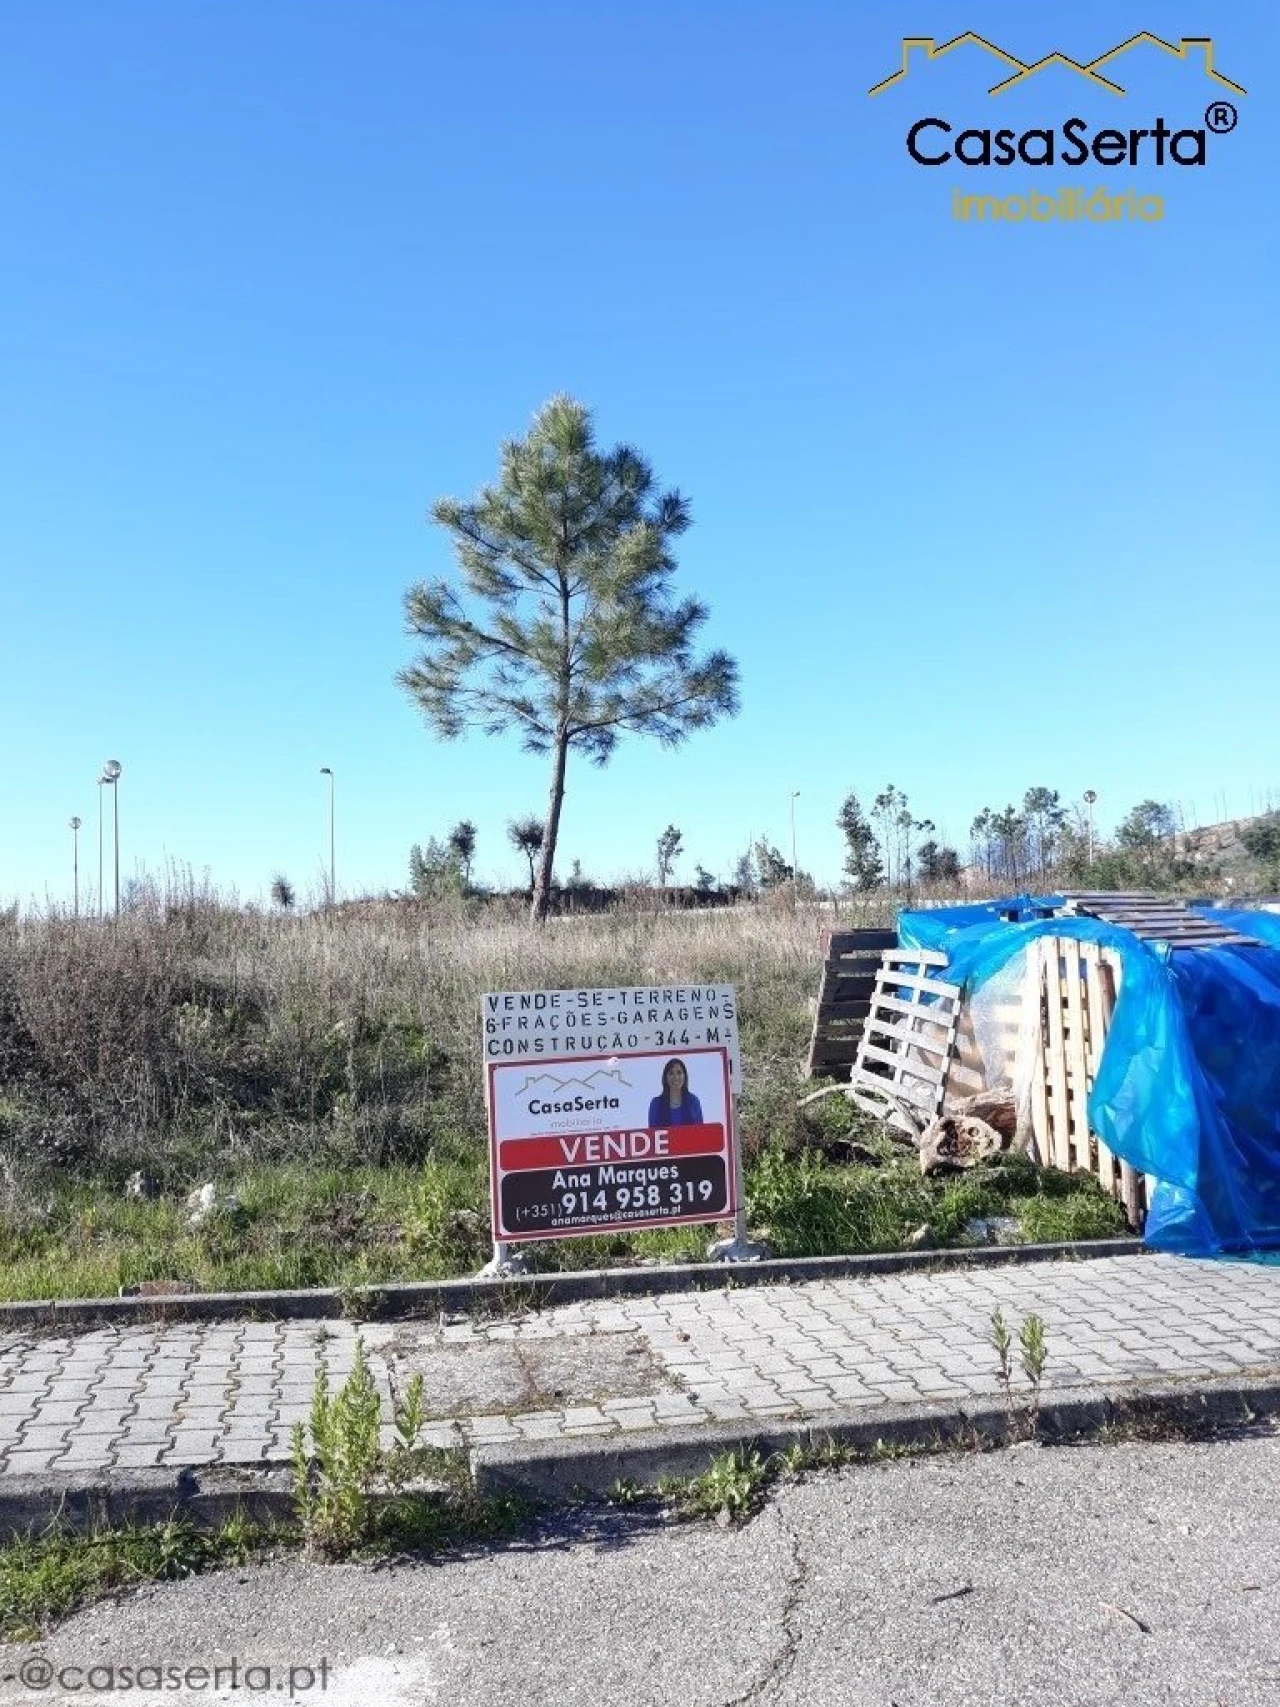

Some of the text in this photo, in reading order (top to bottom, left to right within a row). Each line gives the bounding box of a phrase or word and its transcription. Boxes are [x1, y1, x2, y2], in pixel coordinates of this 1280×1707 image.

[528, 1095, 619, 1115] CasaSerta
[559, 1130, 669, 1163] VENDE
[552, 1165, 679, 1190] Ana Marques
[516, 1179, 713, 1222] (+351) 914 958 319
